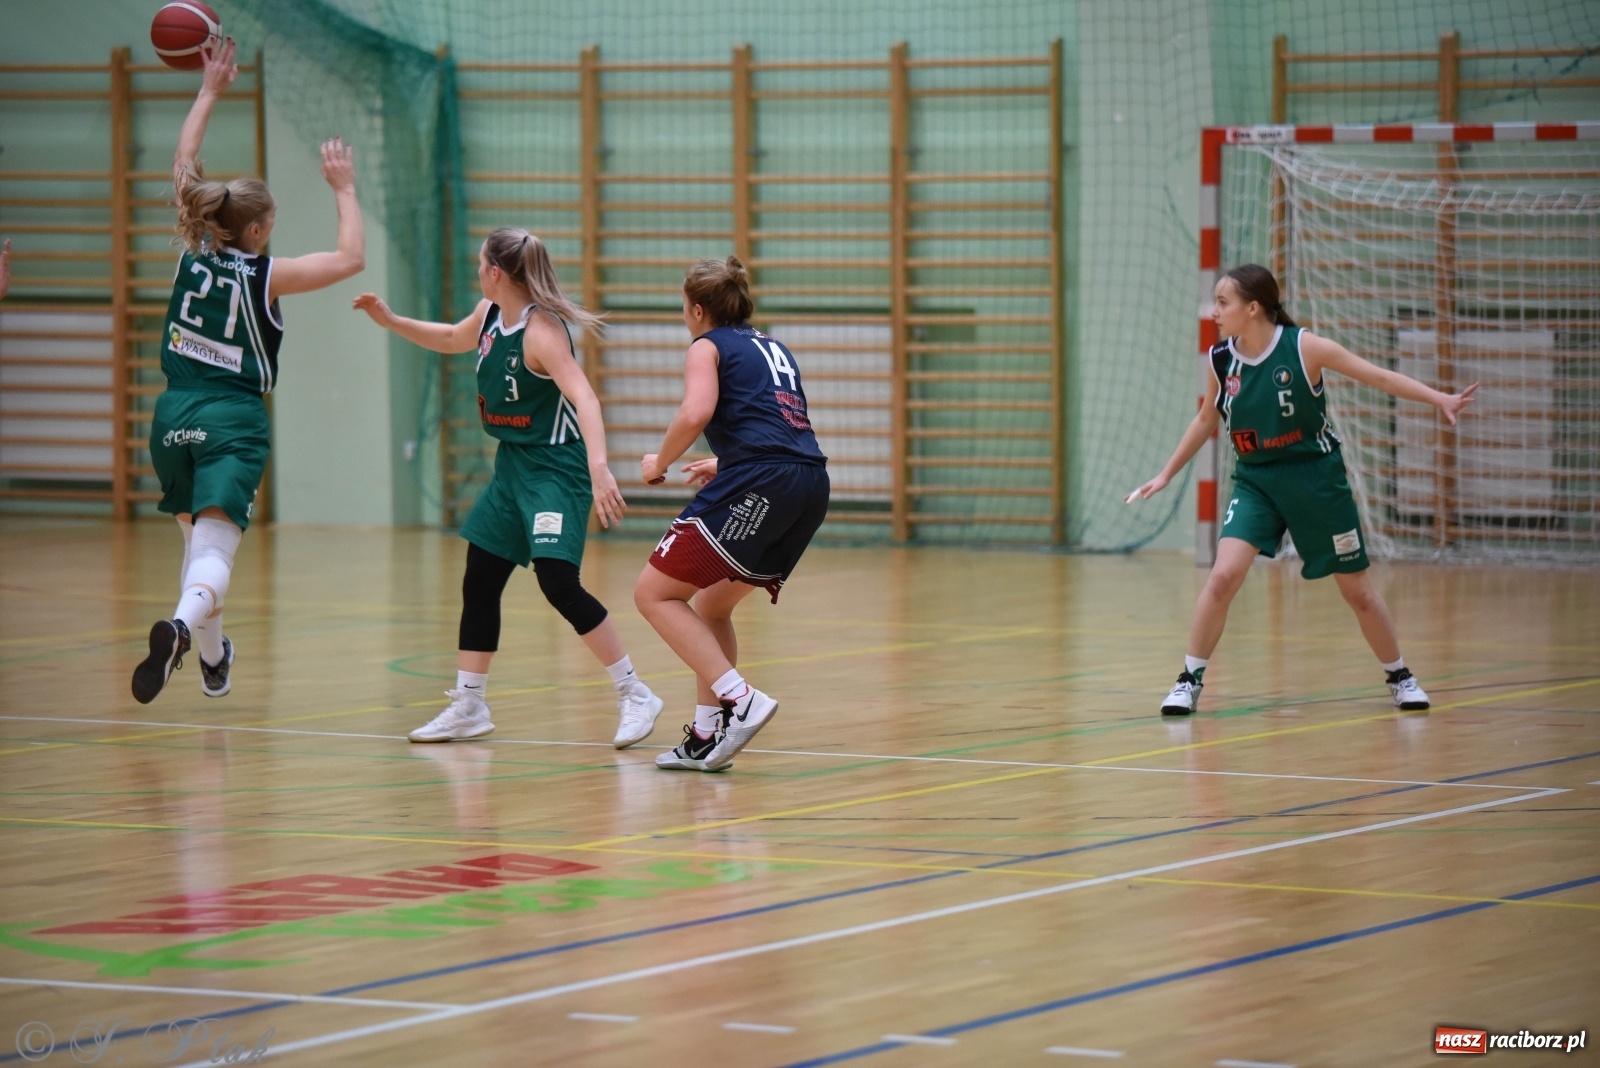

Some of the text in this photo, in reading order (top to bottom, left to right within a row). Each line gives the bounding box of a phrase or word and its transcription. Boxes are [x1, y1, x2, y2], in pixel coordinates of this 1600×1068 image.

[180, 261, 241, 339] 27
[181, 341, 239, 367] WAGTECH
[751, 338, 797, 391] 14
[504, 375, 519, 402] 3
[1278, 389, 1294, 417] 5
[174, 427, 207, 443] Clavis
[753, 504, 770, 529] PASSION
[1223, 498, 1239, 526] 5
